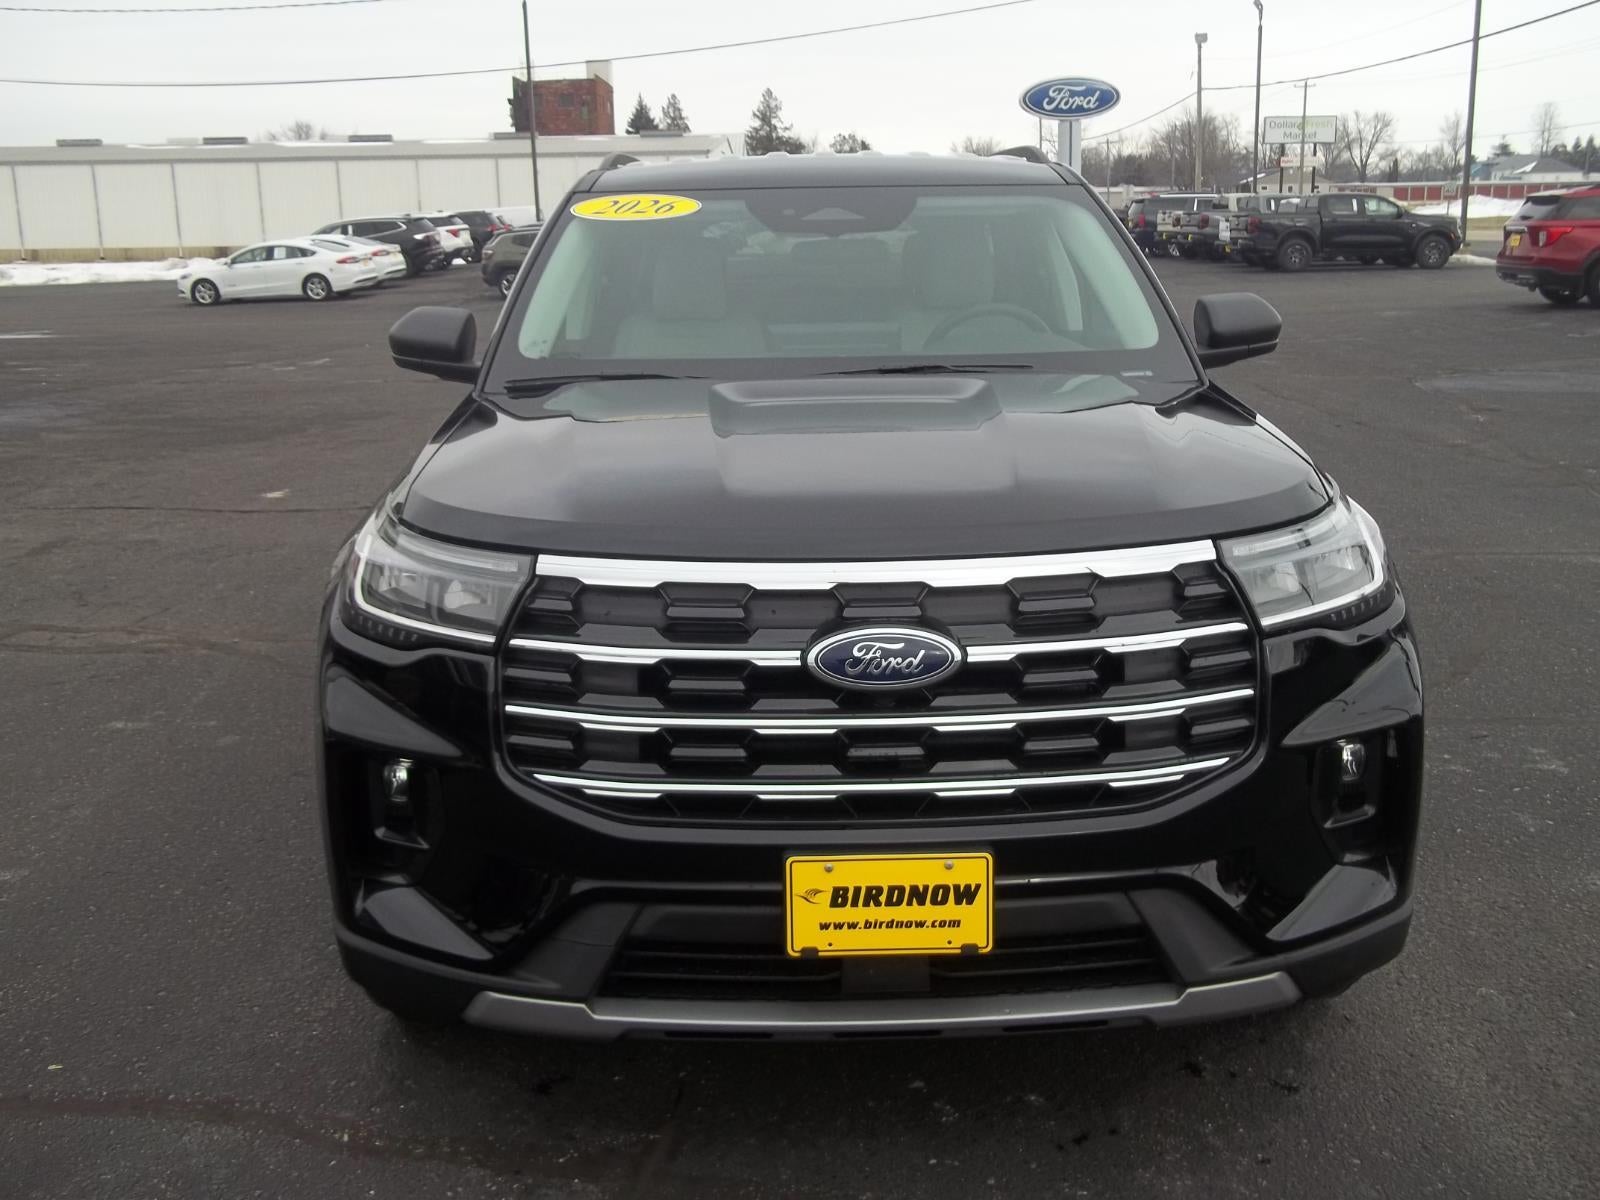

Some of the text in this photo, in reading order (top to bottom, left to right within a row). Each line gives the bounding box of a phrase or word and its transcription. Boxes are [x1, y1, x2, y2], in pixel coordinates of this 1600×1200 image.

[1043, 85, 1100, 111] Ford
[1269, 119, 1297, 129] Dollar
[592, 199, 679, 215] 2026
[845, 641, 926, 675] Ford
[829, 883, 982, 908] BIRDNOW
[819, 918, 961, 931] www.birdnow.com
